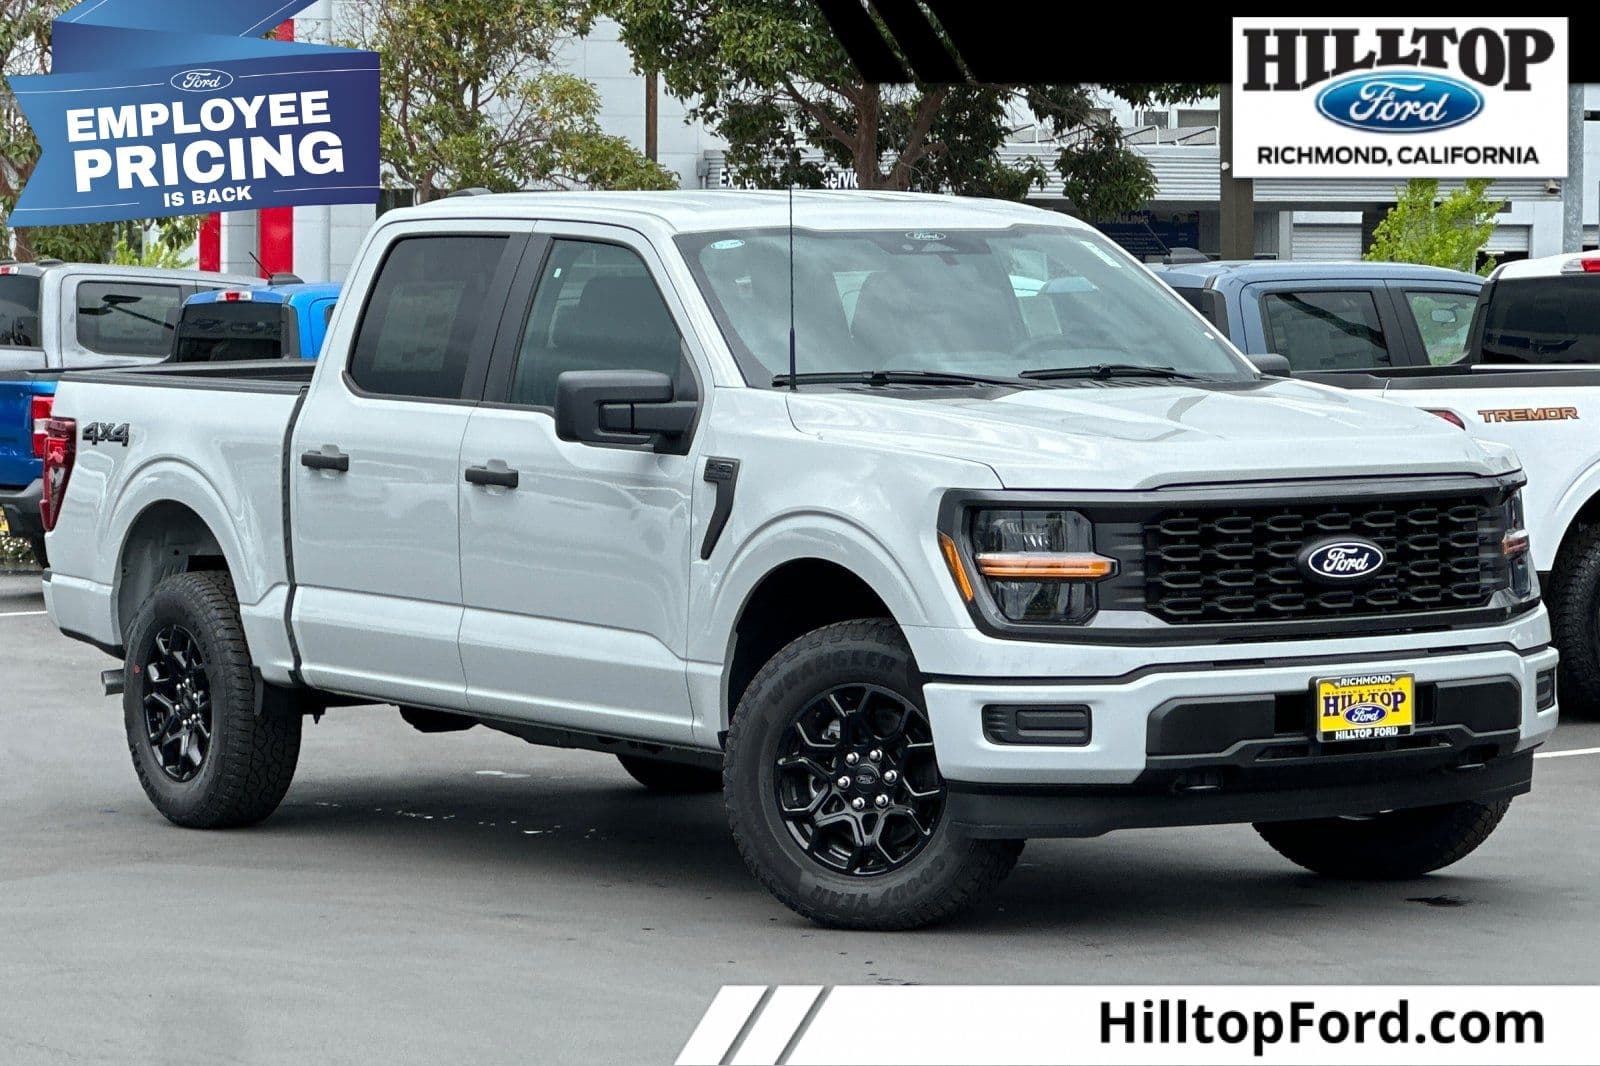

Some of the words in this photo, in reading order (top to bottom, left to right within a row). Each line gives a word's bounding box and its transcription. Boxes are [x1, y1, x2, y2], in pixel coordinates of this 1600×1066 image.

[1477, 407, 1580, 423] TREMOR
[1323, 547, 1369, 572] Ford
[1341, 675, 1391, 687] RICHMOND
[1323, 691, 1406, 717] HILLTOP
[1352, 706, 1379, 722] Ford
[1336, 729, 1372, 740] HILLTOP
[1374, 726, 1399, 737] FORD
